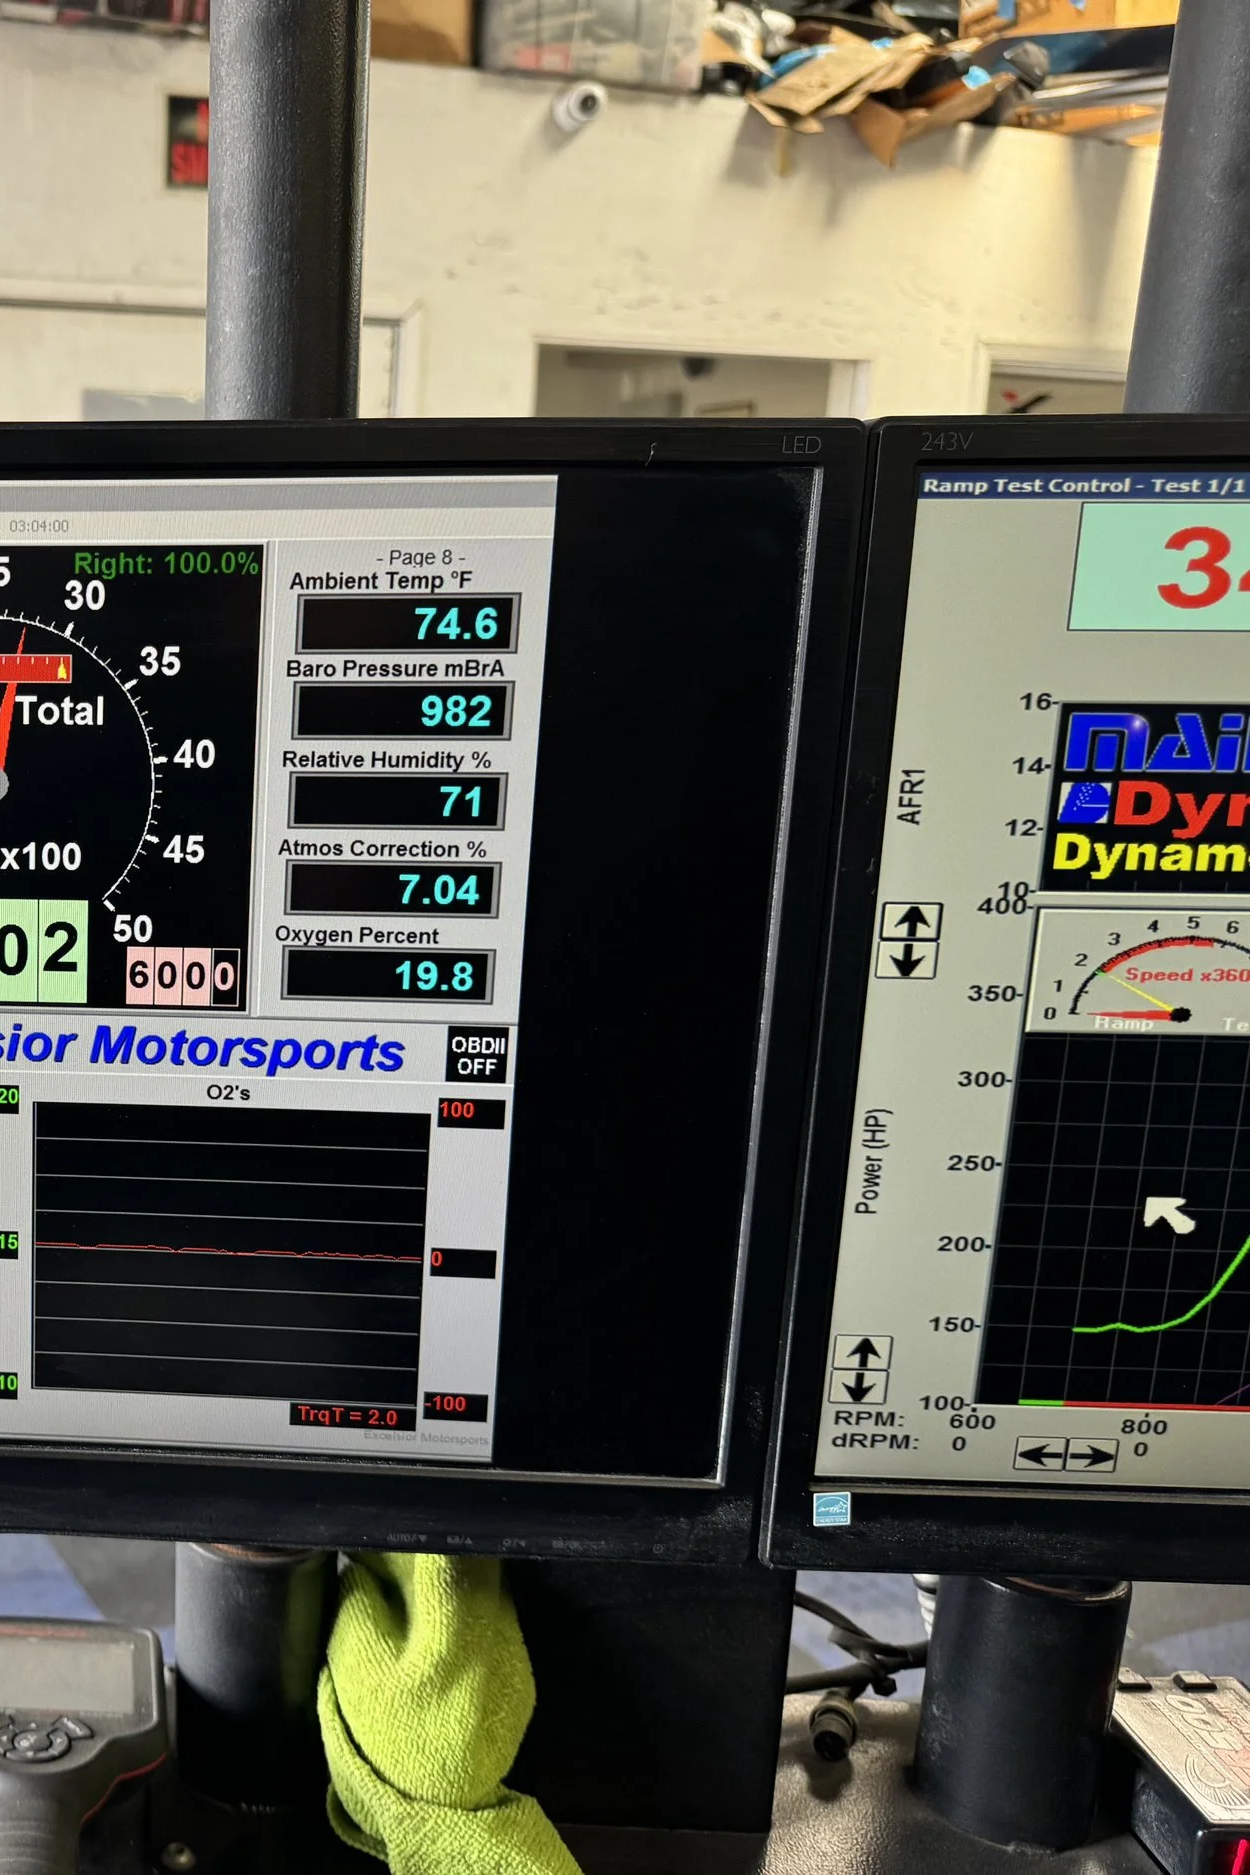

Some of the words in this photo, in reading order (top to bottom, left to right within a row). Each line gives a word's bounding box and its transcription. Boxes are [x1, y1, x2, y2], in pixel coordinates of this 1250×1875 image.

[782, 436, 822, 454] LED
[921, 432, 974, 451] 243V
[923, 478, 989, 495] Ramp
[994, 479, 1044, 493] Test
[1049, 478, 1131, 493] Control
[1151, 479, 1202, 493] Test
[1207, 480, 1246, 495] 1/1
[9, 520, 69, 533] 03:04:00
[75, 552, 154, 580] Right:
[164, 552, 260, 577] 100.0%
[389, 550, 436, 568] Page
[442, 550, 453, 564] 8
[290, 572, 378, 590] Ambient
[386, 572, 444, 593] Temp
[65, 580, 106, 611] 30
[415, 607, 498, 640] 74.6
[139, 646, 181, 677] 35
[287, 660, 337, 677] Baro
[343, 660, 438, 677] Pressure
[444, 659, 505, 677] mBrA
[15, 696, 104, 726] Total
[421, 695, 492, 727] 982
[173, 738, 216, 769] 40
[282, 751, 365, 768] Relative
[371, 751, 465, 772] Humidity
[471, 752, 492, 769] %
[440, 786, 481, 817] 71
[897, 768, 926, 826] AFR1
[0, 842, 82, 872] x100
[163, 835, 205, 863] 45
[278, 839, 343, 857] Atmos
[350, 840, 460, 858] Correction
[467, 841, 487, 858] %
[1053, 833, 1250, 880] Dynam
[399, 874, 479, 905] 7.04
[113, 915, 152, 943] 50
[1187, 916, 1200, 929] 5
[1226, 921, 1239, 934] 6
[275, 925, 353, 946] Oxygen
[359, 927, 439, 945] Percent
[1108, 932, 1121, 946] 3
[1074, 953, 1088, 967] 2
[130, 960, 236, 992] 6000
[395, 961, 473, 991] 19.8
[1126, 968, 1193, 984] Speed
[1044, 1007, 1057, 1020] 0
[90, 1025, 405, 1077] Motorsports
[451, 1036, 506, 1055] OBDII
[457, 1057, 498, 1076] OFF
[206, 1084, 251, 1101] O2's
[439, 1102, 474, 1119] 100
[862, 1108, 894, 1150] (HP)
[855, 1153, 884, 1215] Power
[431, 1251, 442, 1267] 0
[424, 1395, 467, 1412] -100
[298, 1405, 346, 1425] TrqT
[368, 1409, 398, 1425] 2.0
[834, 1410, 904, 1428] RPM:
[950, 1414, 996, 1431] 600
[1121, 1418, 1168, 1436] 800
[421, 1432, 489, 1446] Motorsports
[832, 1433, 919, 1451] dRPM:
